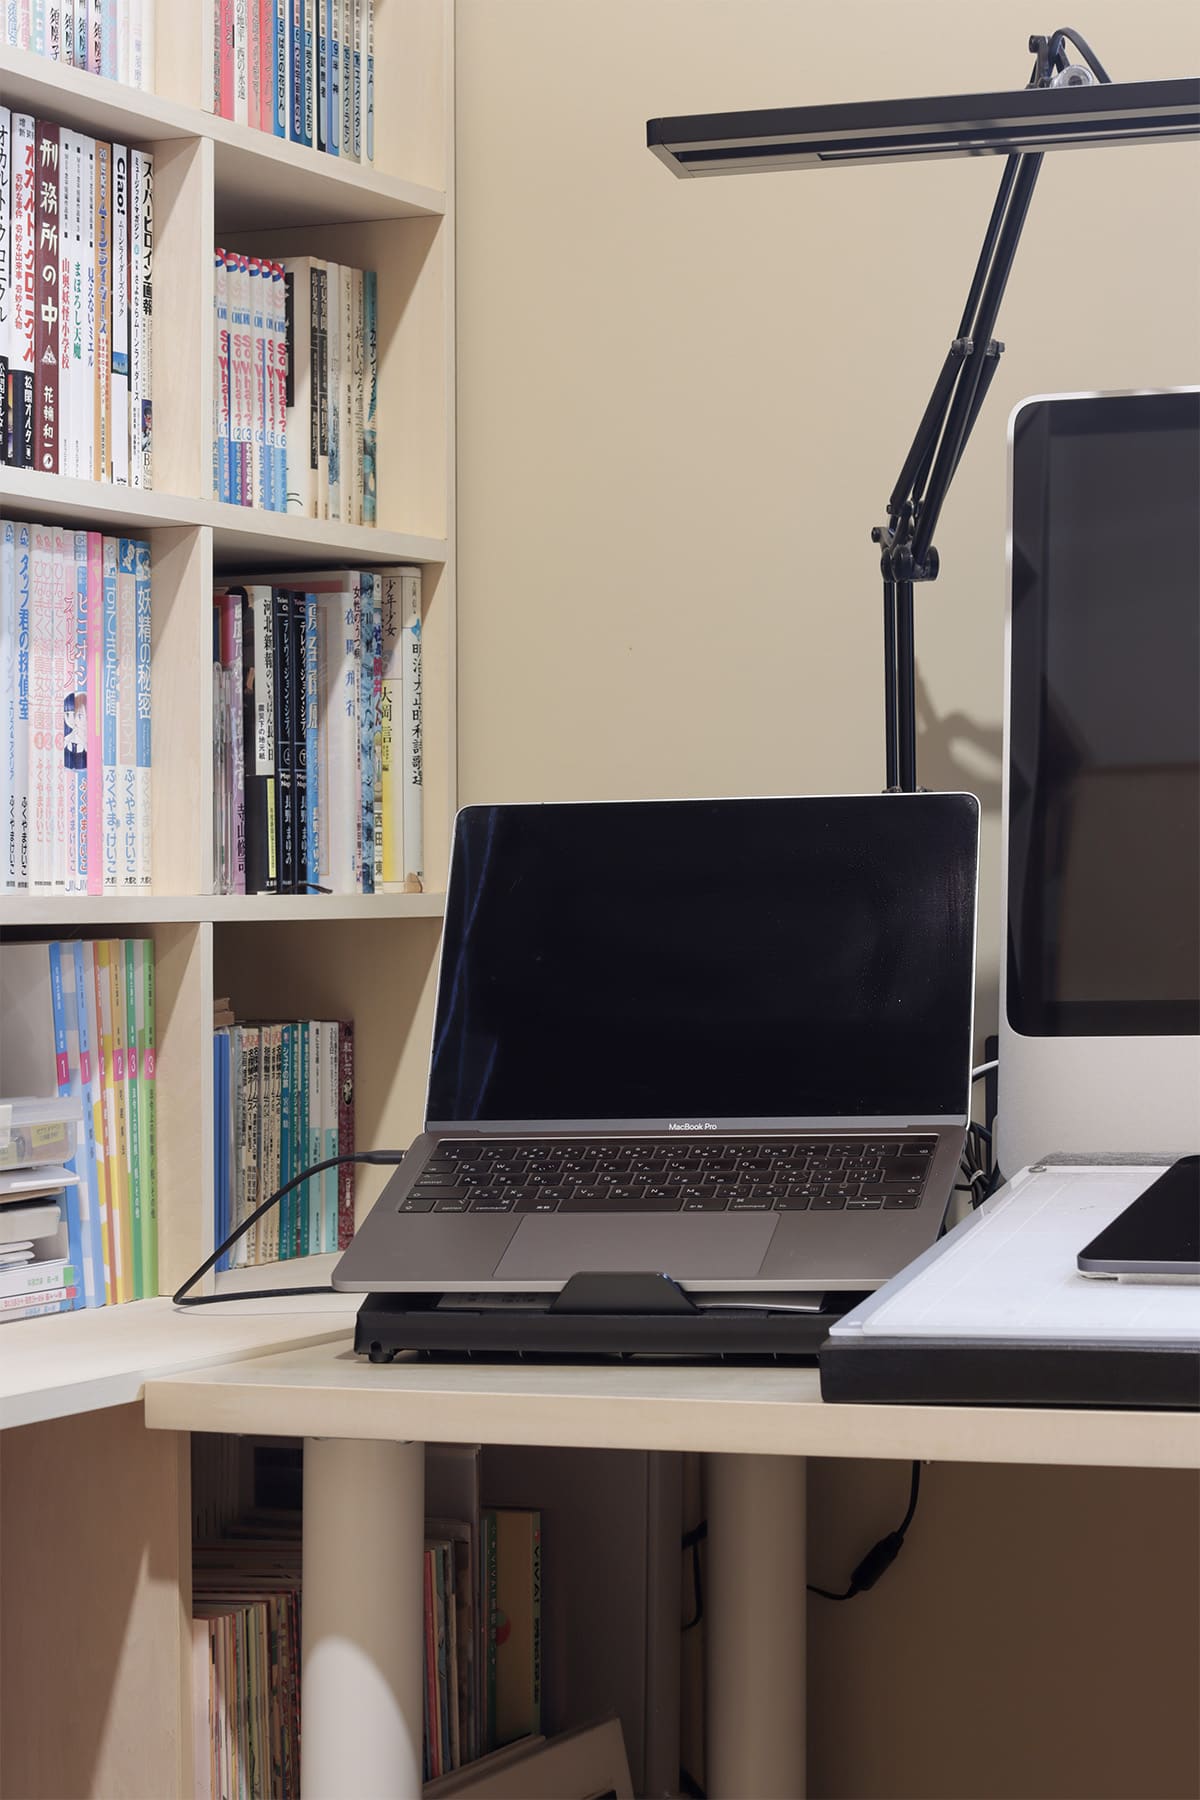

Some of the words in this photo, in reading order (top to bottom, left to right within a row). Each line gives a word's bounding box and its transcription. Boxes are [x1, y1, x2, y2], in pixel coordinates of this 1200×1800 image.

[117, 157, 126, 215] Ciao!
[40, 138, 58, 336] 刑務所の中
[141, 161, 154, 316] スーパーヒロイン画報
[62, 257, 70, 369] 山奥妖怪小学校
[276, 342, 287, 366] So
[43, 385, 55, 448] 花輪和一
[18, 555, 29, 720] タップ君の探偵室
[384, 578, 397, 638] 少年少女
[138, 585, 152, 720] 妖精の秘密
[343, 1041, 353, 1078] 紅い花
[668, 1123, 703, 1131] MacBook
[704, 1123, 718, 1131] Pro
